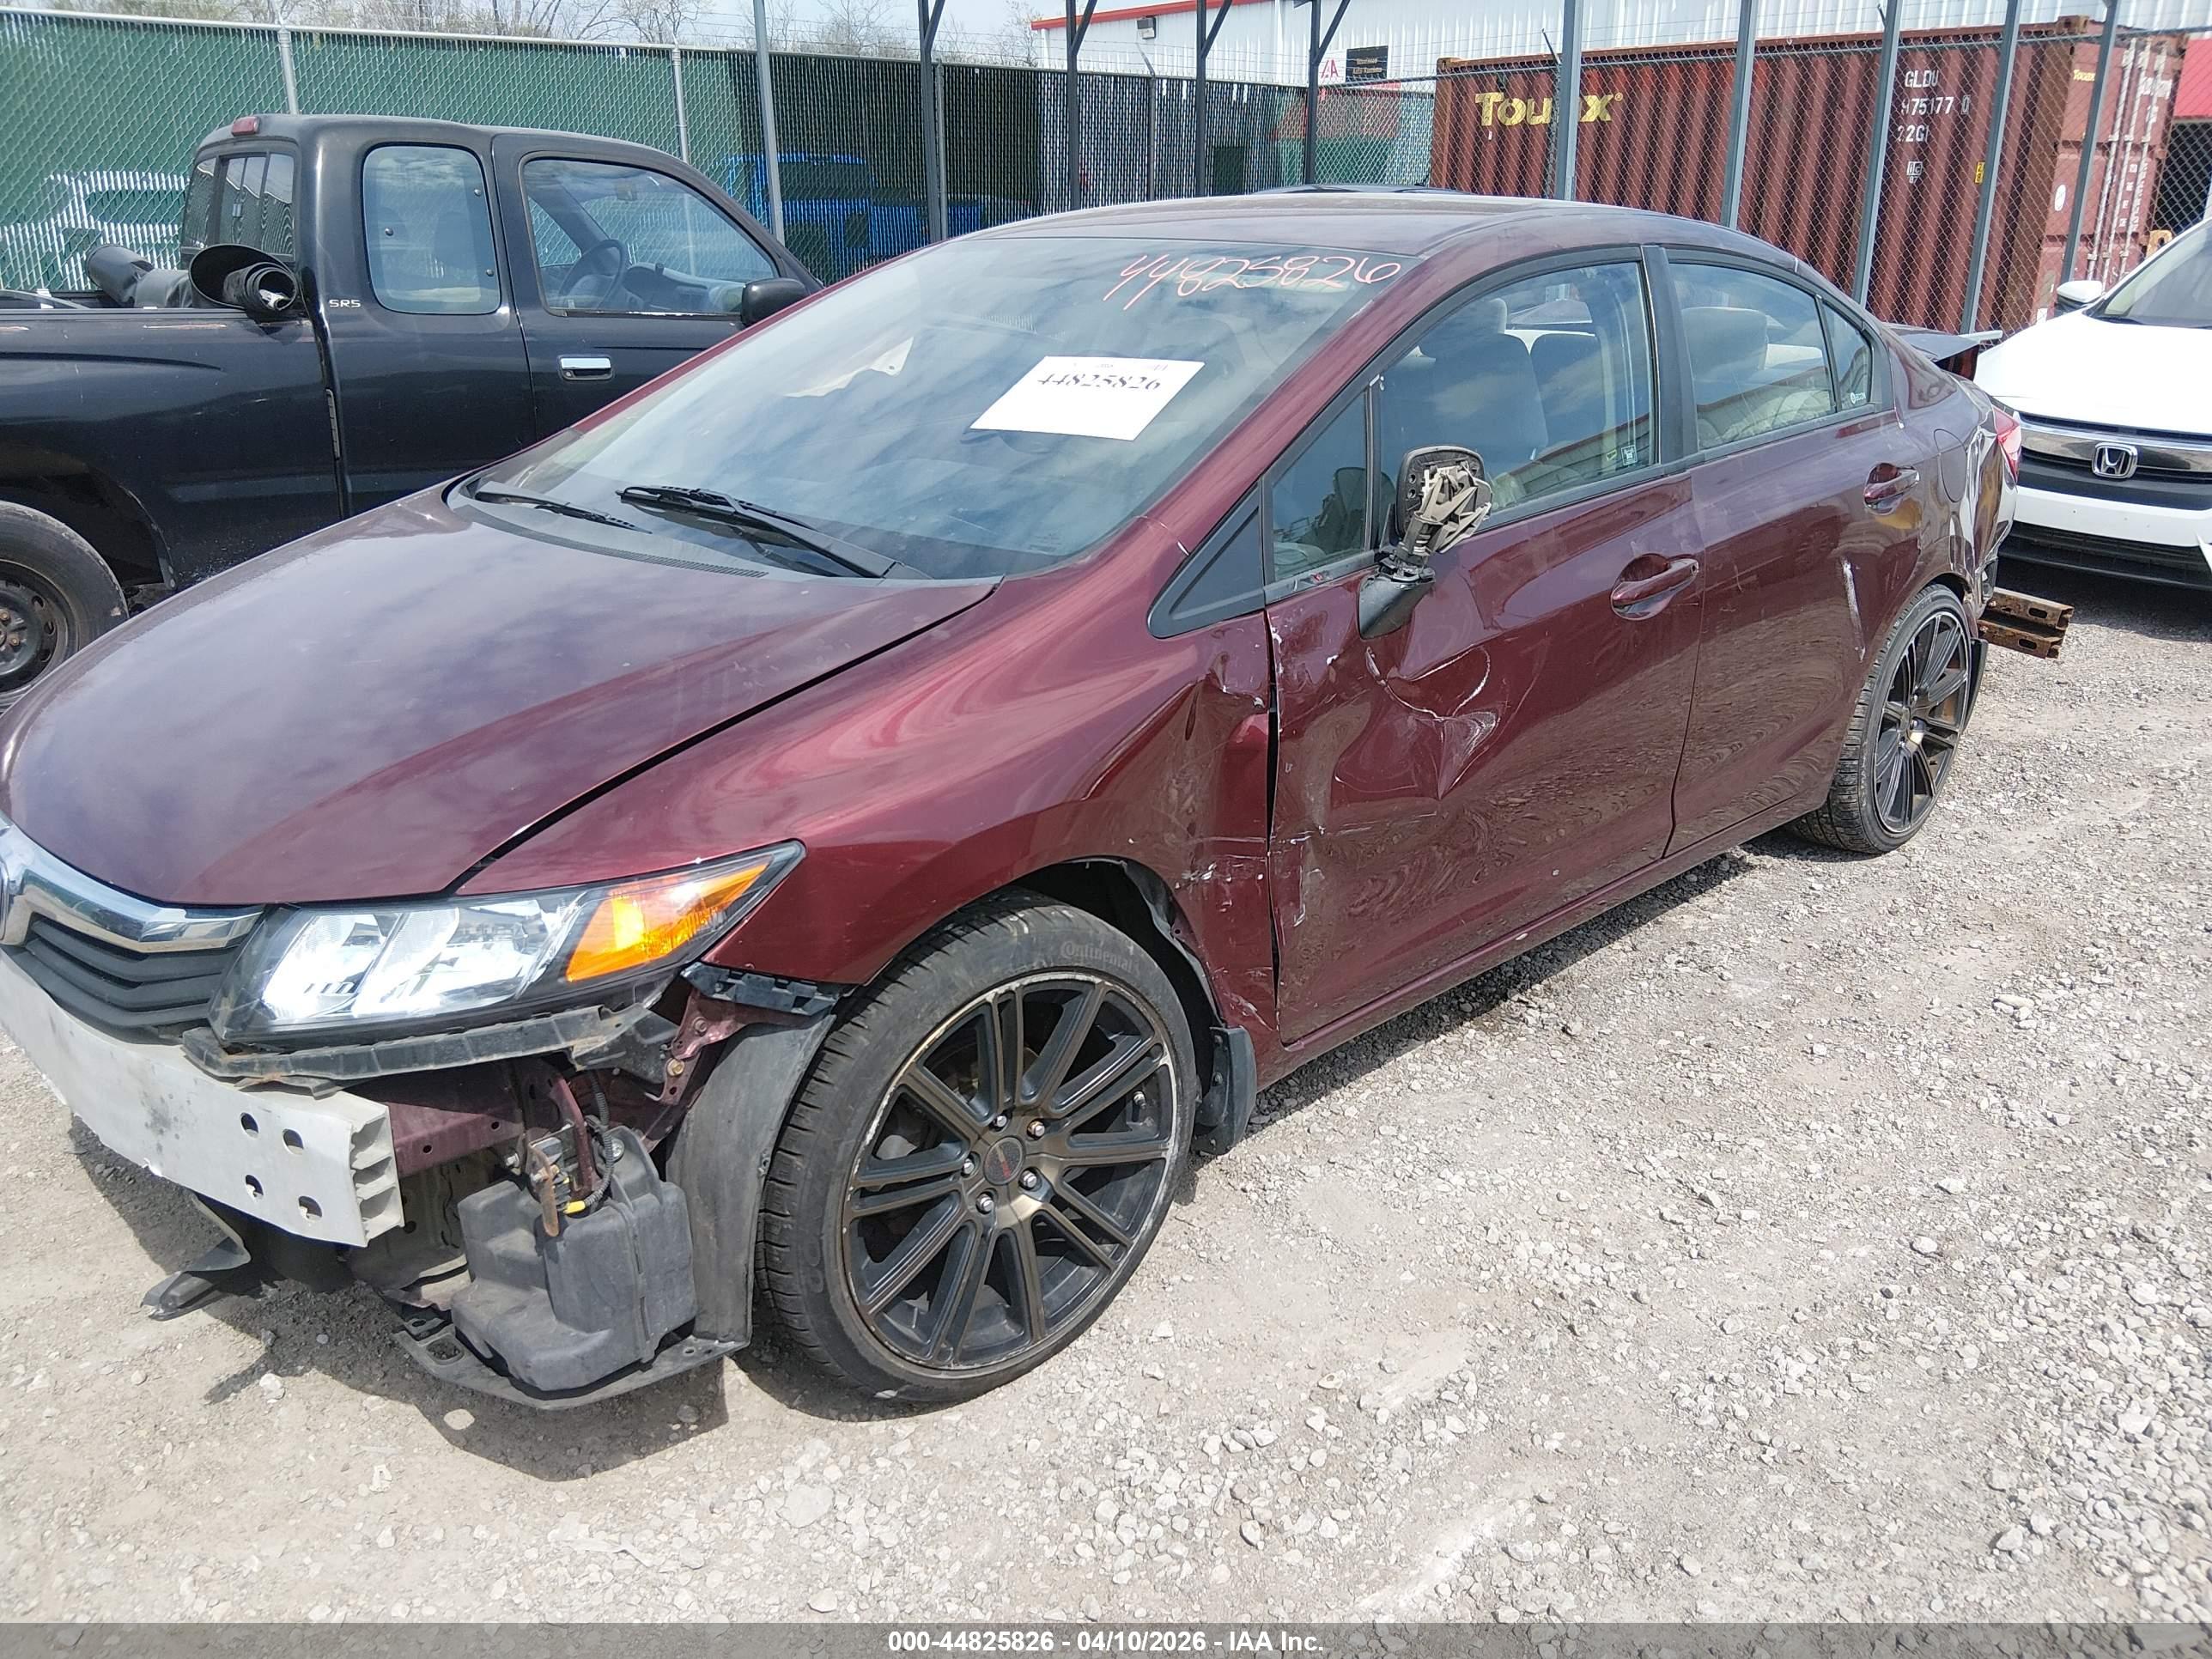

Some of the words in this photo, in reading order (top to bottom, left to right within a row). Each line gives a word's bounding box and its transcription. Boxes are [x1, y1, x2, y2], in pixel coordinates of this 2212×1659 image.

[1905, 70, 1939, 88] GLDU
[1103, 253, 1401, 311] 44825826
[329, 299, 361, 308] SR5
